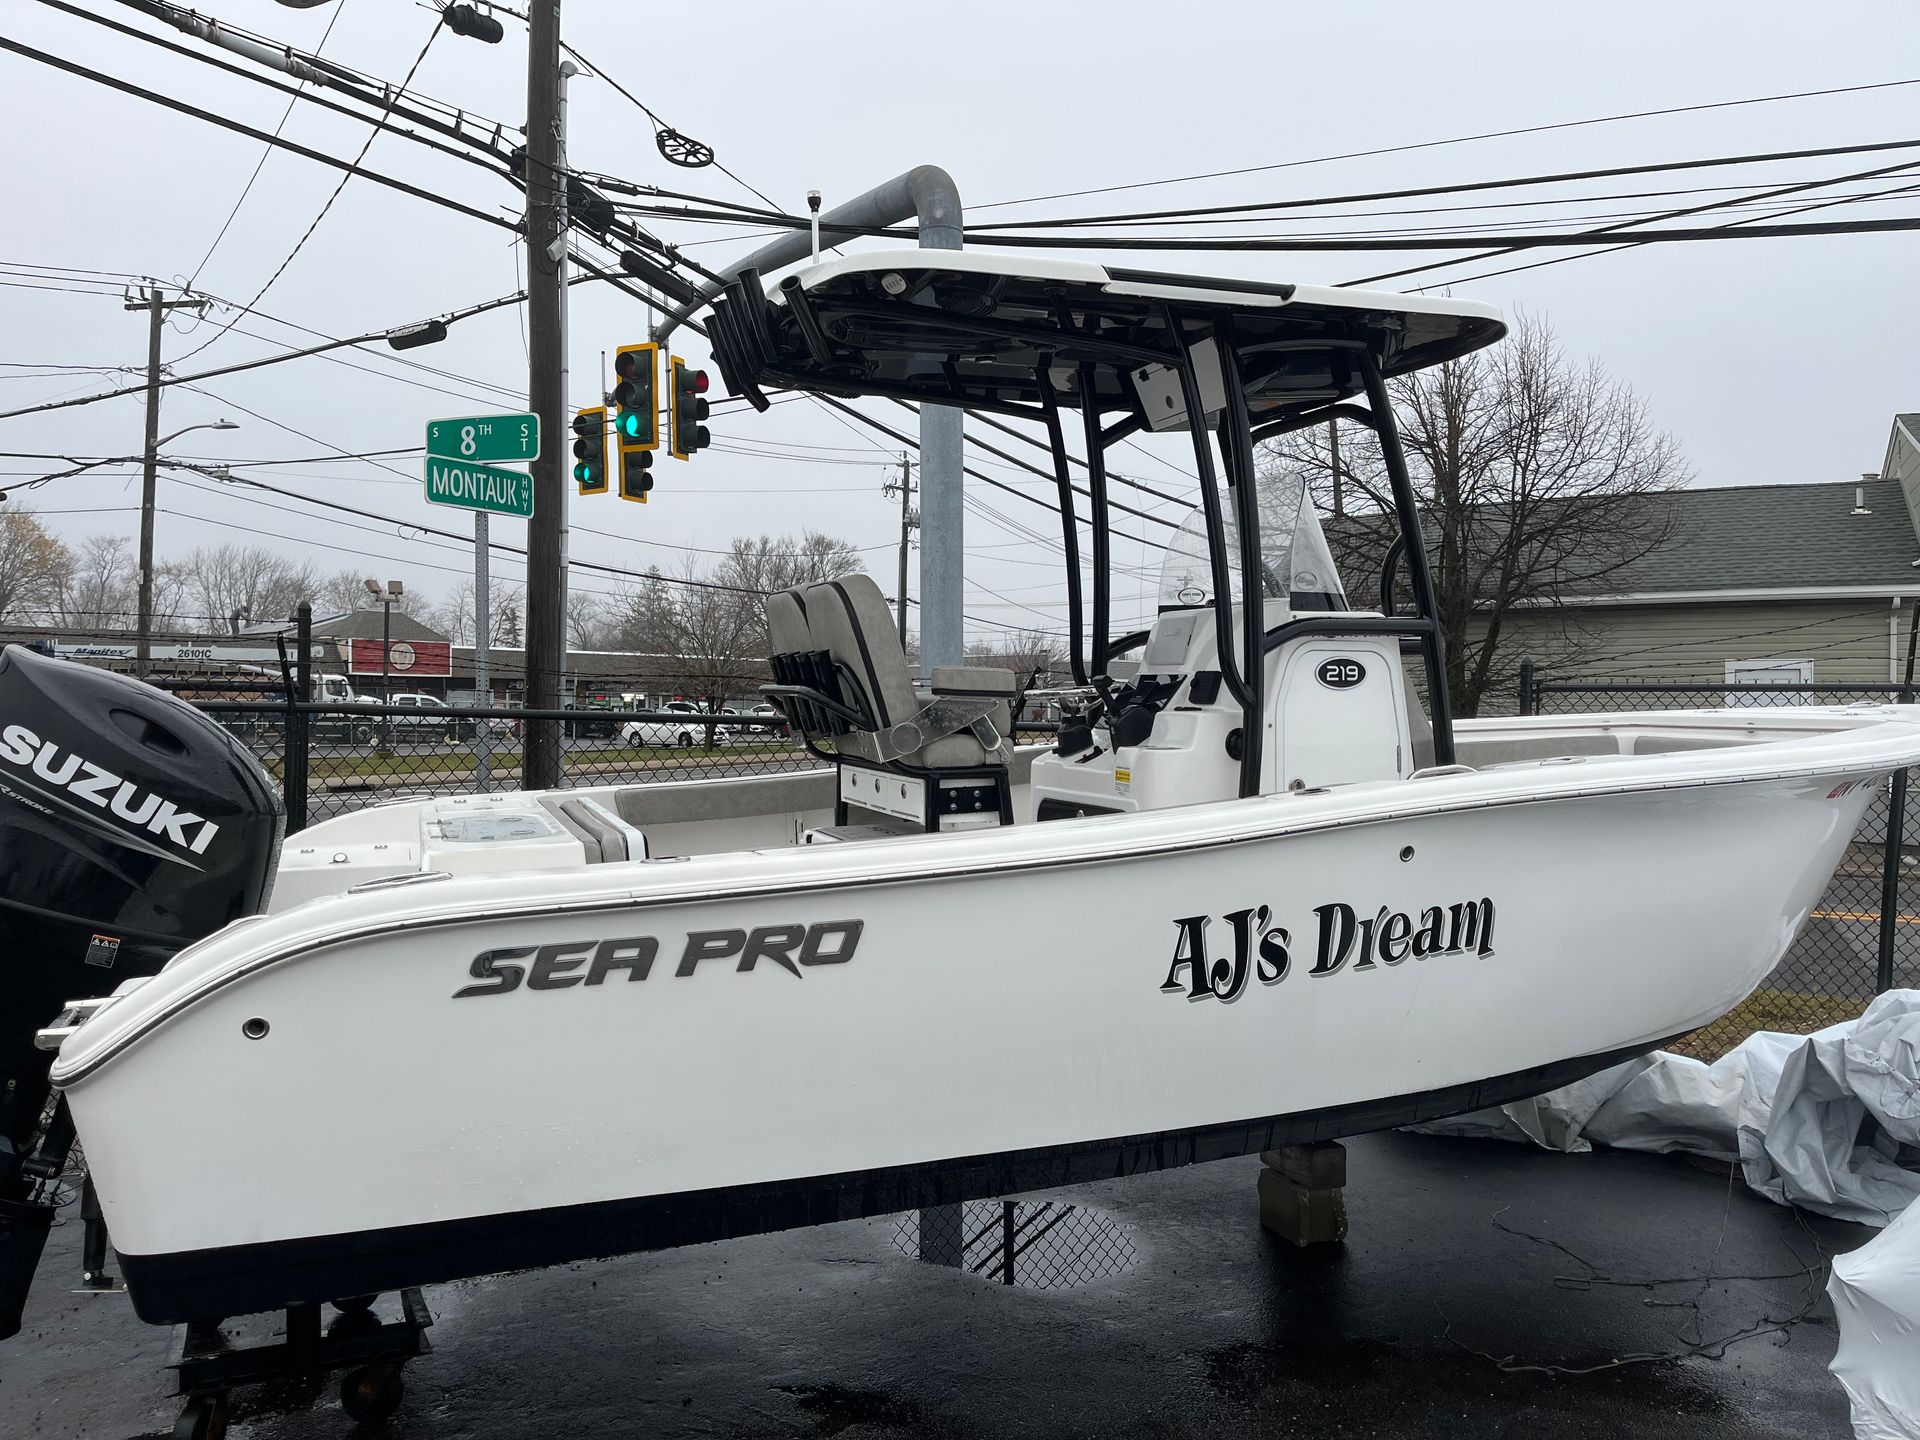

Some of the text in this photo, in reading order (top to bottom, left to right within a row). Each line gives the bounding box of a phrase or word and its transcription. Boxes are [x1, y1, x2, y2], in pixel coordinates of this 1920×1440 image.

[432, 427, 439, 438] S
[432, 465, 529, 511] MONTAUK HWY
[177, 649, 212, 659] 26101C
[1326, 665, 1359, 681] 219
[0, 725, 219, 855] SUZUKI
[452, 918, 865, 999] SEA PRO
[1159, 897, 1495, 1005] AJ's Dream
